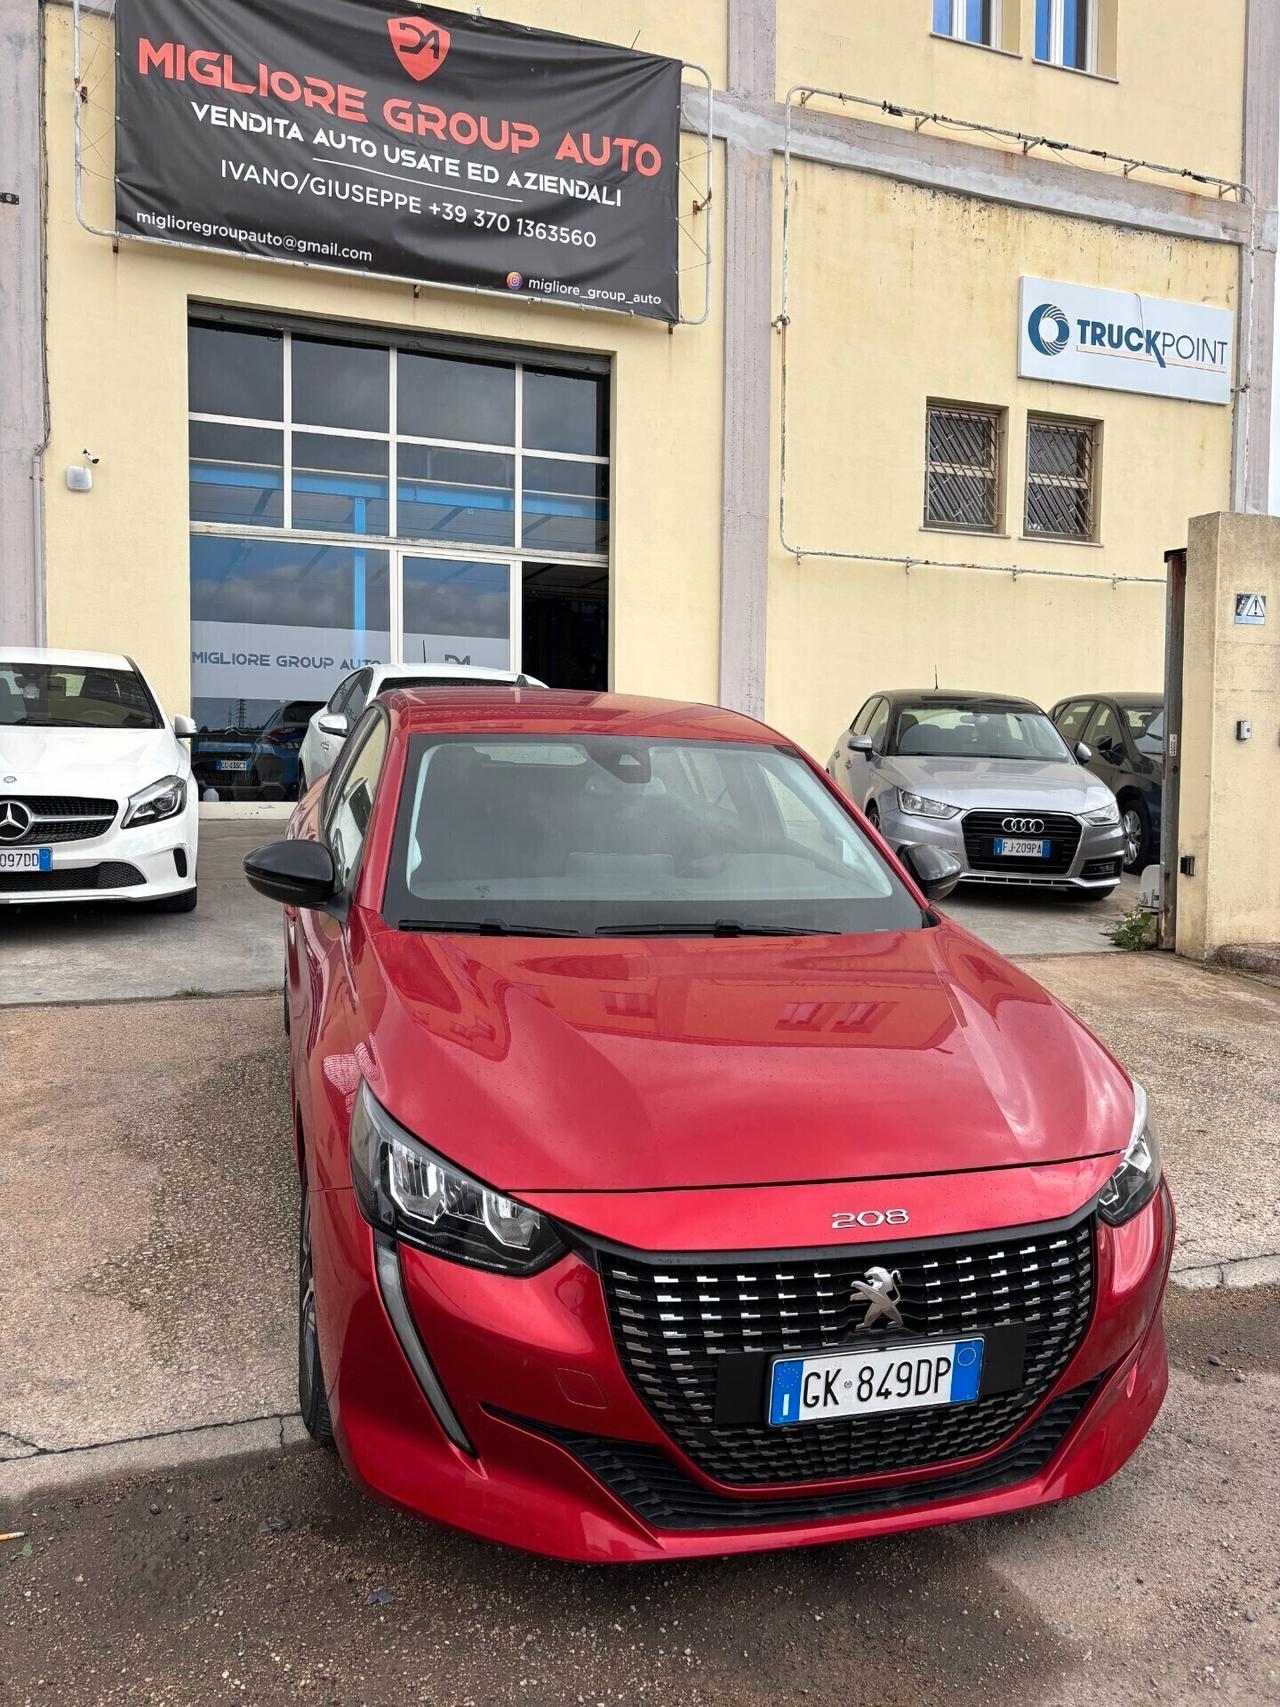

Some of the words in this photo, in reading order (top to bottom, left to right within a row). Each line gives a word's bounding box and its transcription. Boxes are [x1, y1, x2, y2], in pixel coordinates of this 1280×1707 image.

[138, 38, 368, 123] MIGLIORE
[383, 98, 540, 155] GROUP
[555, 131, 662, 178] AUTO
[190, 101, 304, 144] VENDITA
[312, 127, 378, 159] AUTO
[383, 145, 461, 178] USATE
[466, 161, 500, 185] ED
[506, 170, 623, 207] AZIENDALI
[220, 158, 422, 215] IVANO/GIUSEPPE
[428, 203, 467, 223] +39
[472, 208, 511, 232] 370
[516, 218, 597, 248] 1363560
[135, 211, 374, 262] miglioregroupauto@gmail.com
[528, 278, 662, 305] migliore_group_auto
[1077, 317, 1228, 368] TRUCKPOINT
[191, 651, 271, 667] MIGLIORE
[276, 655, 335, 670] GROUP
[831, 1208, 911, 1230] 208
[802, 1367, 841, 1409] GK
[856, 1356, 952, 1402] 849DP
